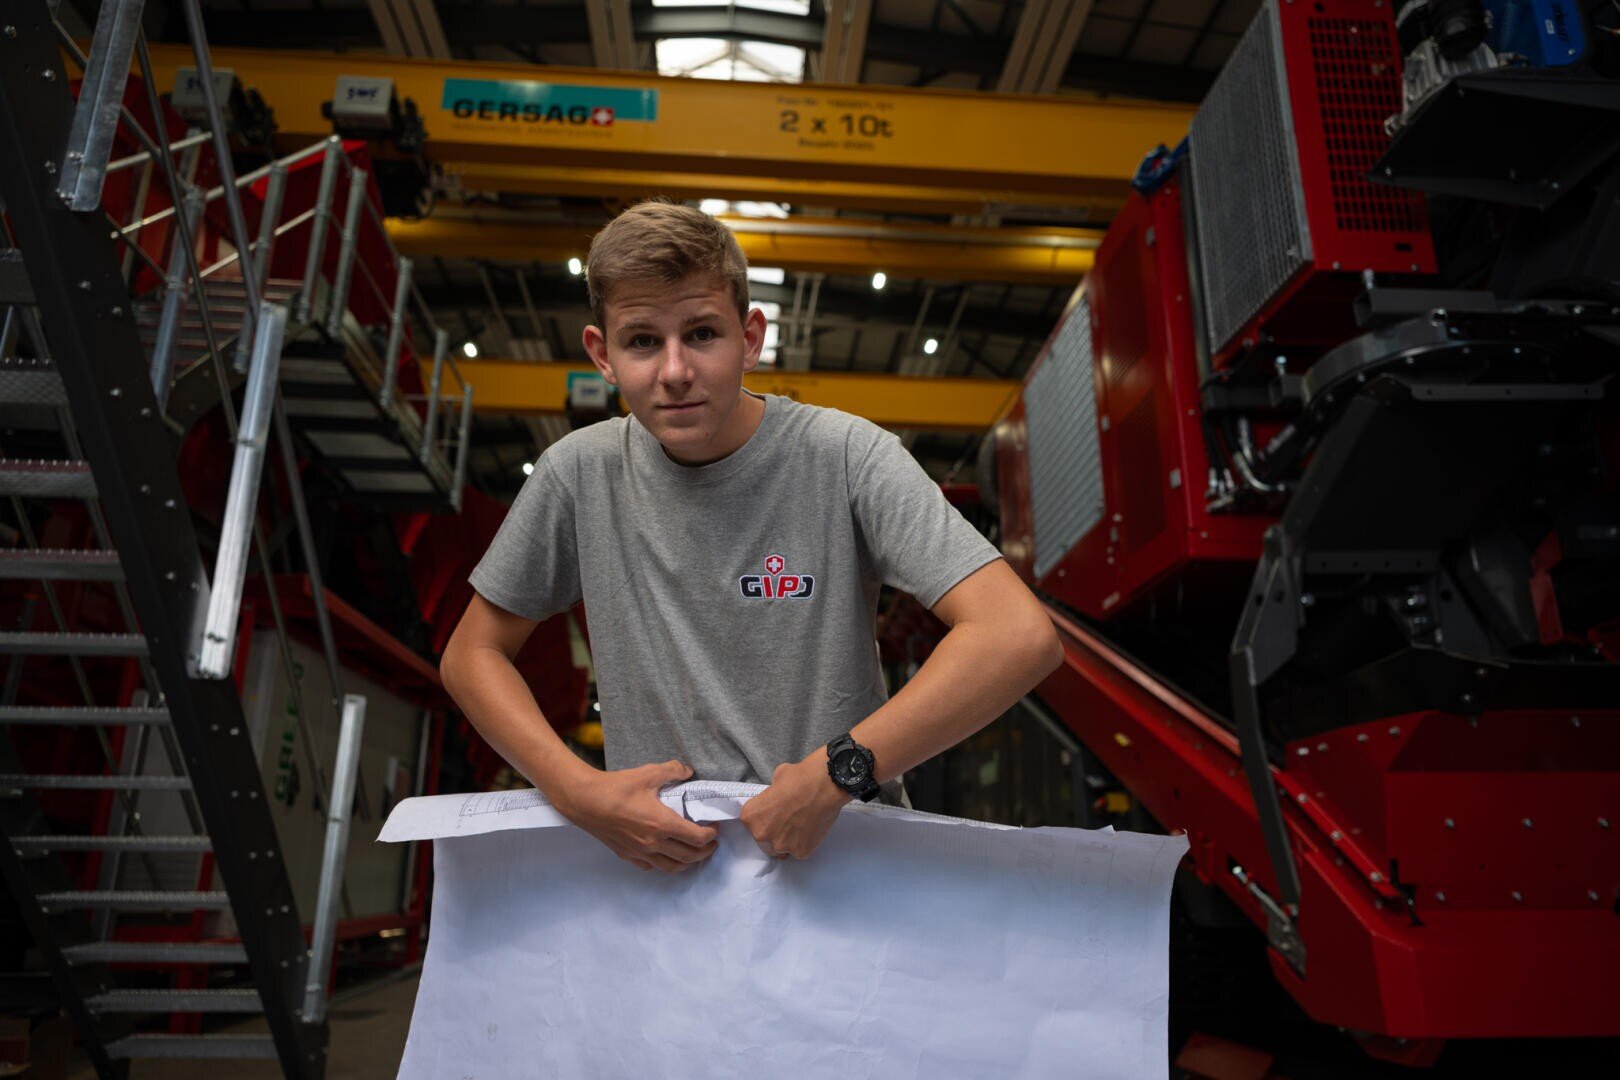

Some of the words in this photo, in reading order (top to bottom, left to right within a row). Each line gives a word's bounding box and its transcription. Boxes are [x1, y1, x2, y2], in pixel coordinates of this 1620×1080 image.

[453, 98, 588, 125] GERSAG
[779, 109, 799, 133] 2
[811, 117, 827, 134] x
[840, 113, 893, 138] 10t
